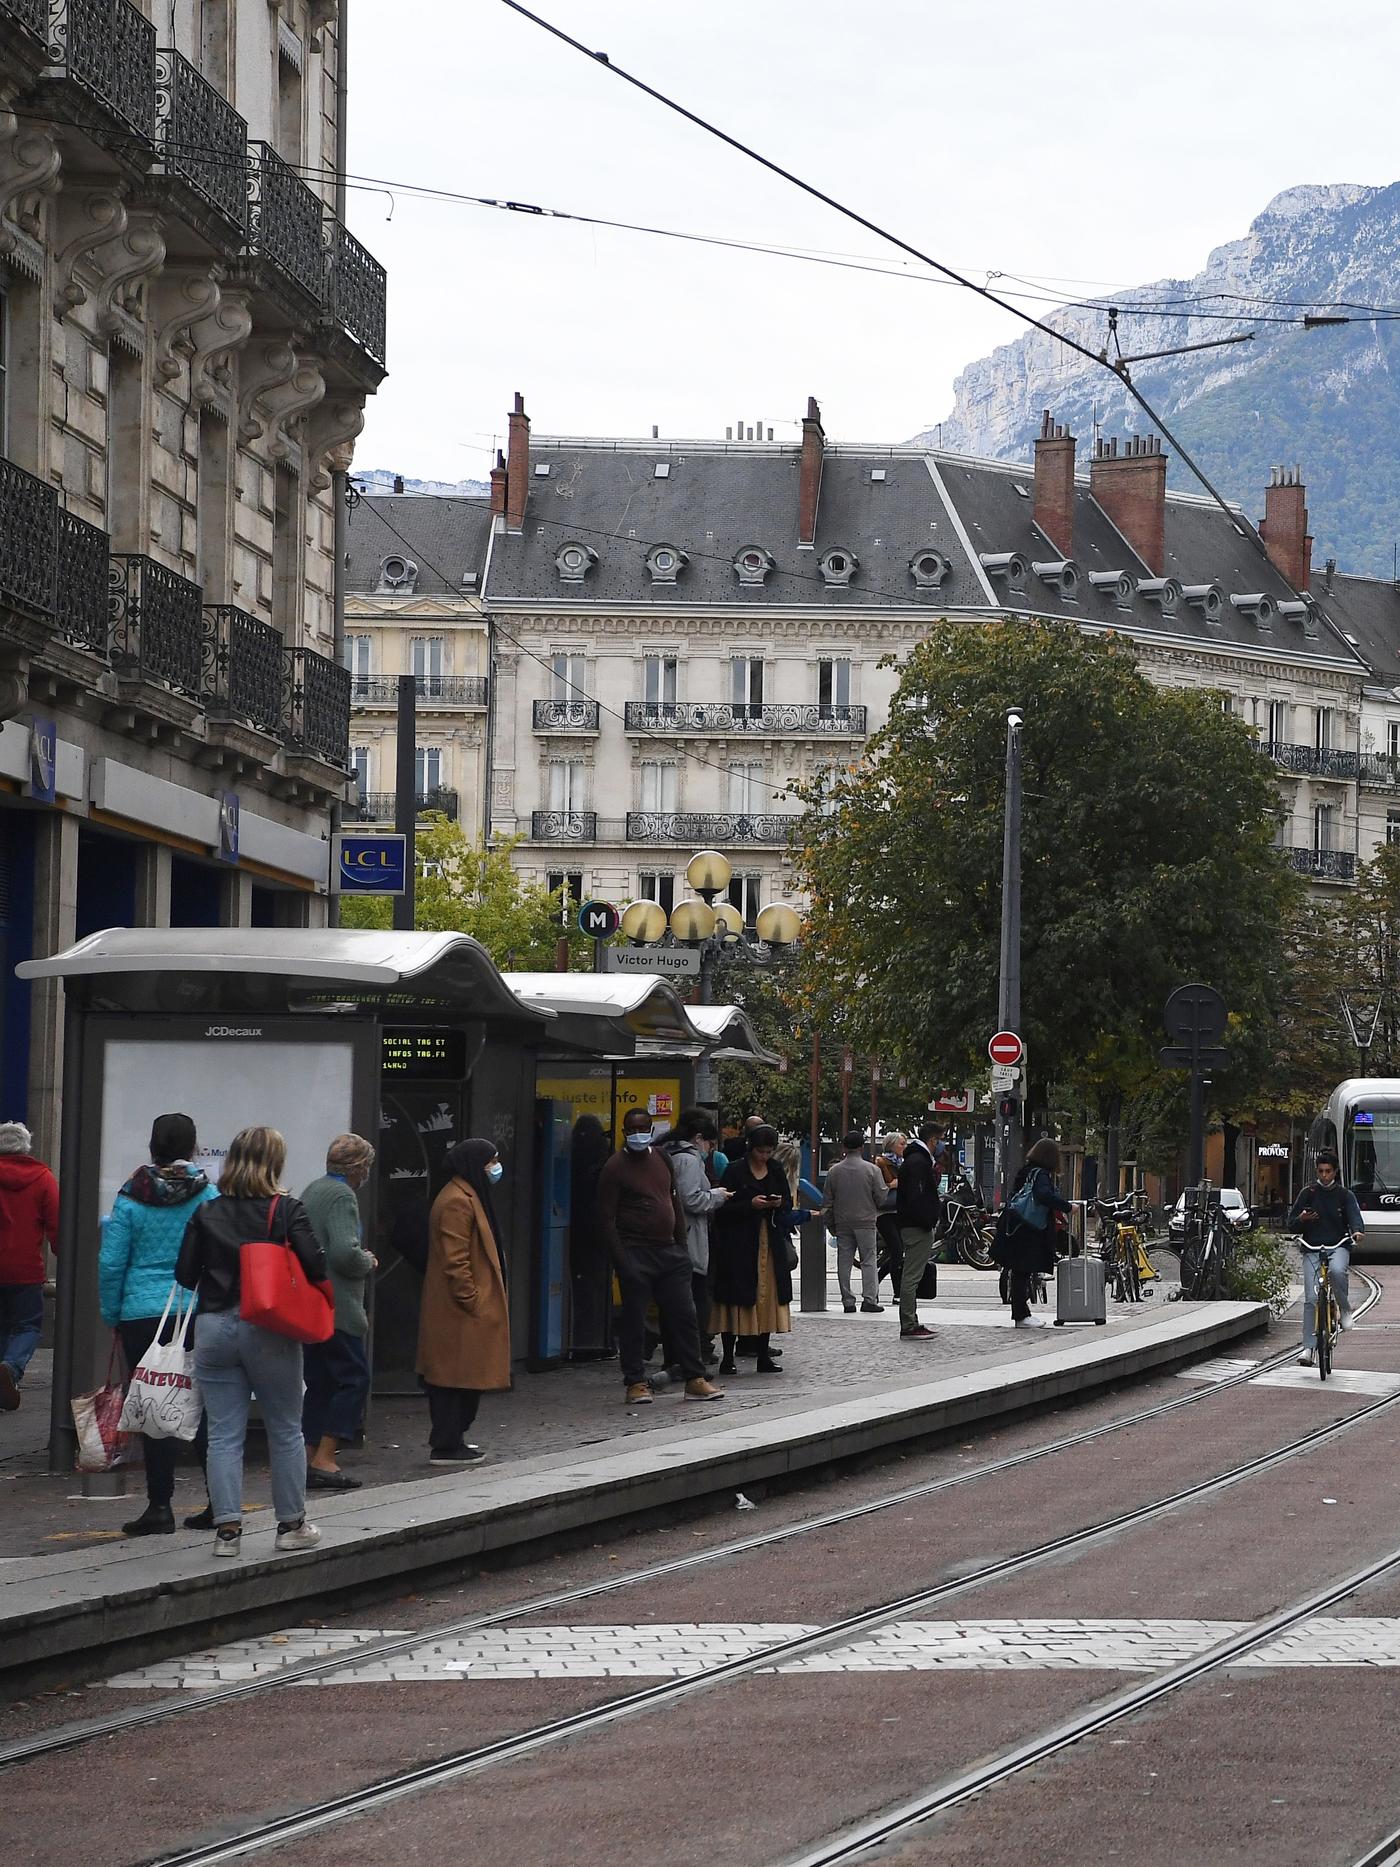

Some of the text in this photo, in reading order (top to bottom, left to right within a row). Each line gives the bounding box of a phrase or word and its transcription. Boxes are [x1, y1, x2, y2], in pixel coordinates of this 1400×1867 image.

[344, 850, 396, 867] LCL
[590, 912, 606, 928] M
[616, 954, 689, 968] Victor Hugo
[204, 1026, 263, 1036] JCDecaux
[383, 1038, 412, 1046] SOCIAL
[416, 1038, 432, 1046] TAG
[388, 1050, 412, 1058] INFOS
[563, 1091, 597, 1105] juste
[1258, 1147, 1289, 1158] PROVOST
